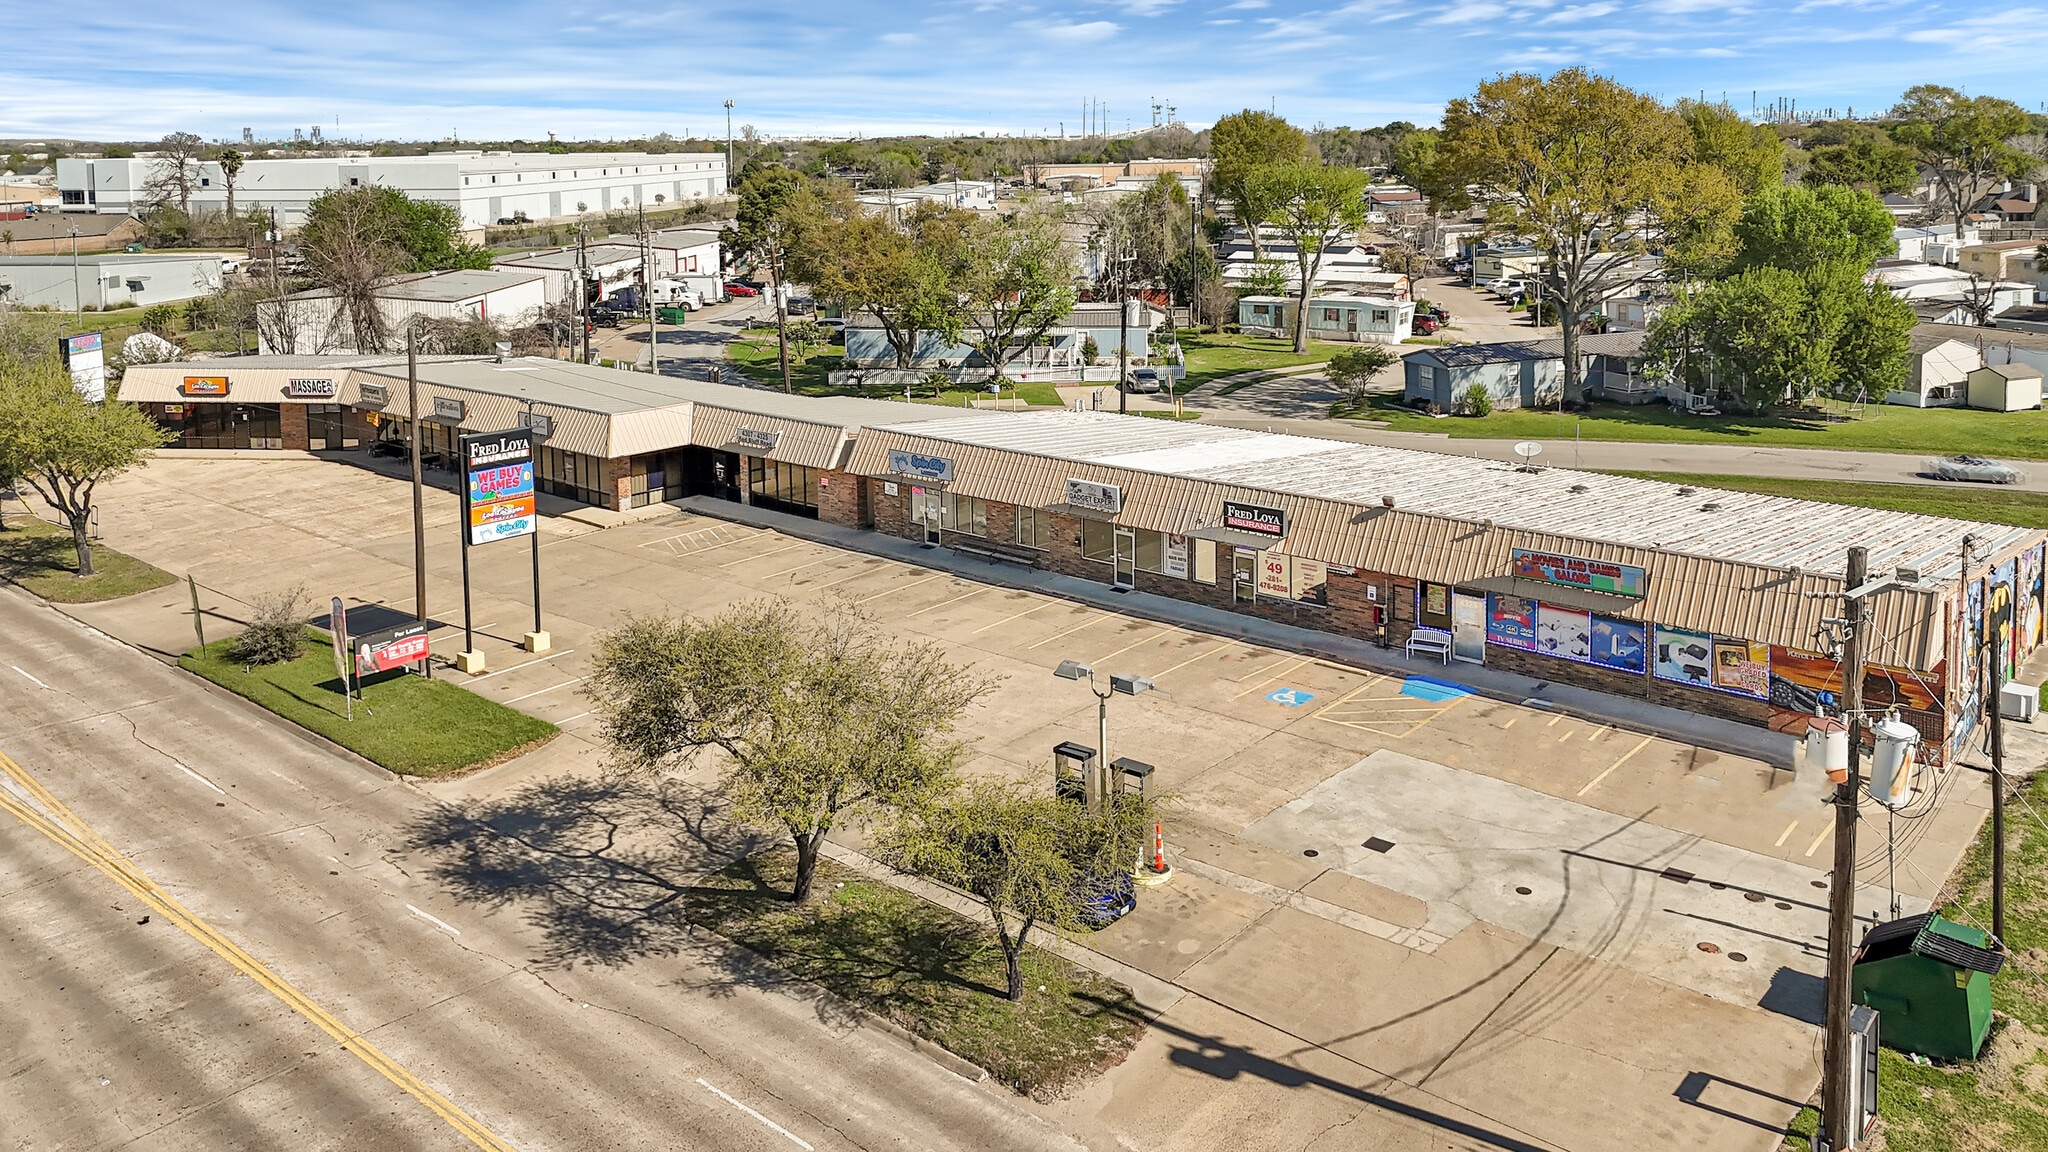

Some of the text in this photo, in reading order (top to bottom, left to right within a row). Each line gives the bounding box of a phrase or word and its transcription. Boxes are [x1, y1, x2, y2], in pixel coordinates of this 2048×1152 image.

[290, 380, 326, 393] MASSAGE
[470, 437, 530, 458] FRED LOYA
[474, 449, 528, 465] INSURANCE
[911, 455, 928, 469] Spin
[928, 457, 947, 474] City
[478, 465, 522, 484] WE BUY
[480, 476, 520, 494] GAMES
[1069, 492, 1092, 501] GADGET
[1093, 497, 1116, 506] EXPERT
[1227, 504, 1281, 525] FRED LOYA
[1230, 518, 1279, 532] INSURANCE
[1532, 553, 1621, 578] MOVIES AND GAMES
[1554, 568, 1591, 585] GALORE
[1504, 613, 1522, 622] MOVIE
[1506, 636, 1528, 647] SERIES
[1740, 660, 1750, 668] WE
[1740, 668, 1766, 678] GRADED
[1741, 682, 1764, 692] CARDS
